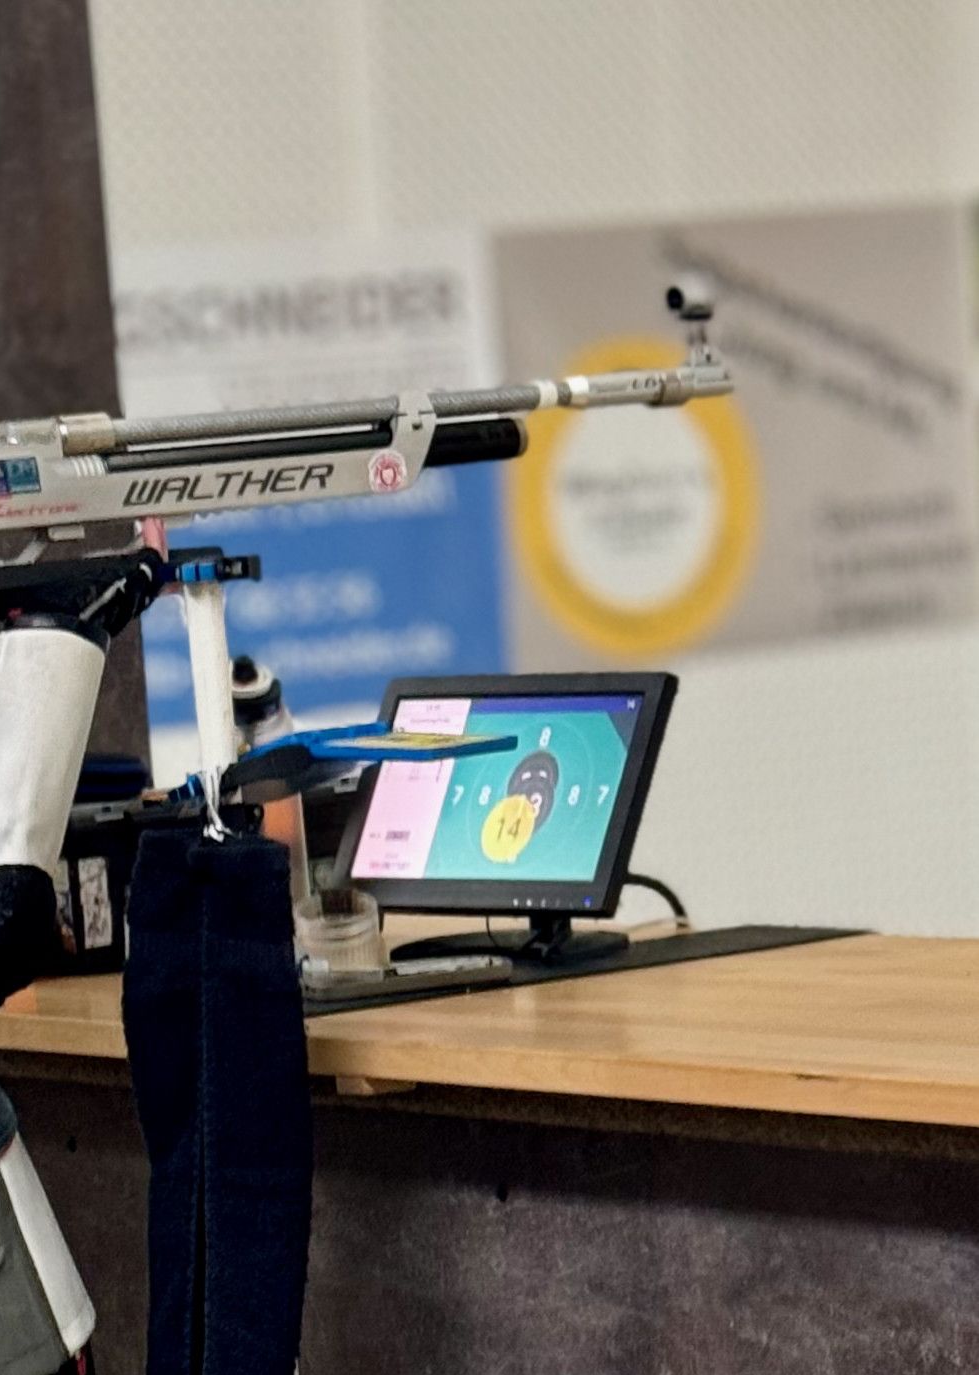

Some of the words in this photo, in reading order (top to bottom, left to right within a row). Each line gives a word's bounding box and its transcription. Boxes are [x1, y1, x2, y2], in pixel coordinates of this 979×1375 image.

[122, 463, 334, 507] WALTHER
[452, 785, 464, 806] 7
[597, 785, 609, 807] 7
[496, 817, 521, 842] 14
